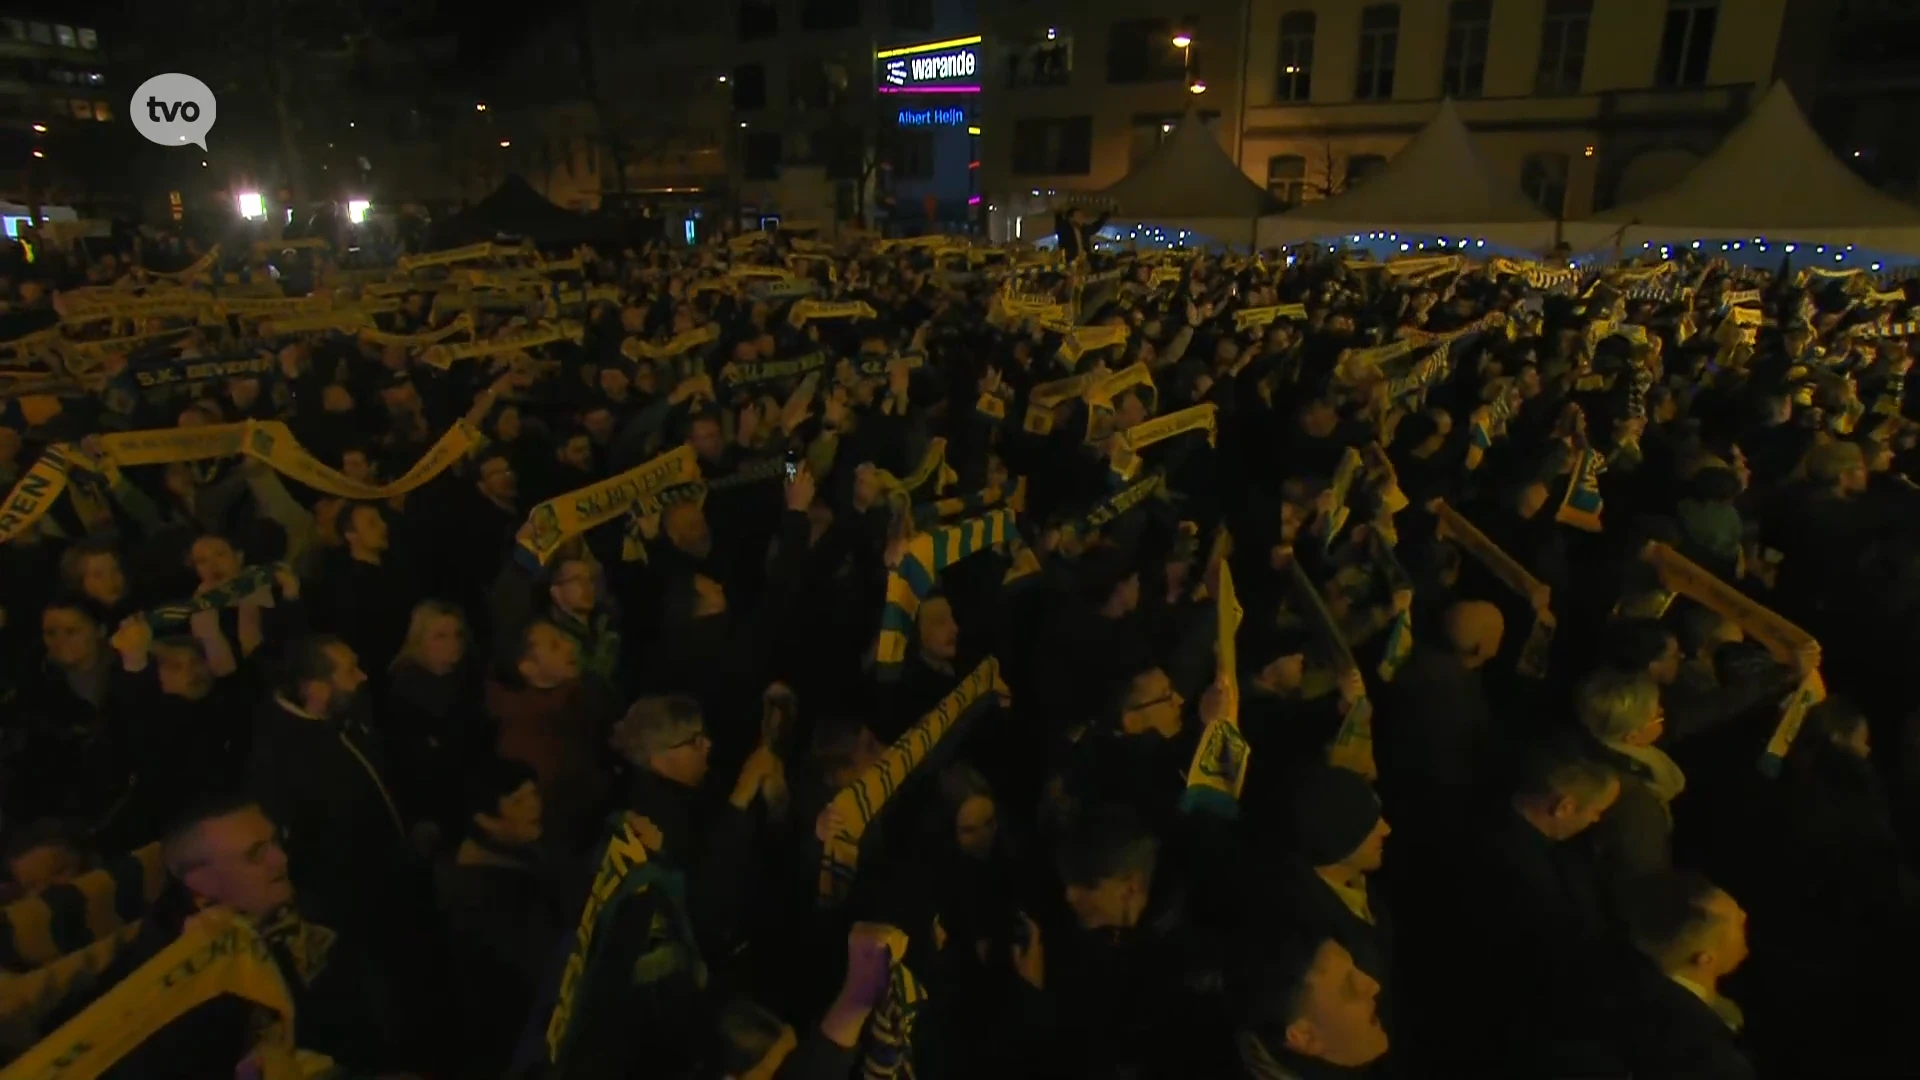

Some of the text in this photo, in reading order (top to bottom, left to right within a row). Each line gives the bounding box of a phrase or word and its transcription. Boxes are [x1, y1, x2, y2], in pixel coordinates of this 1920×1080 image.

[911, 50, 976, 81] warande
[898, 108, 964, 126] Albert Heijn
